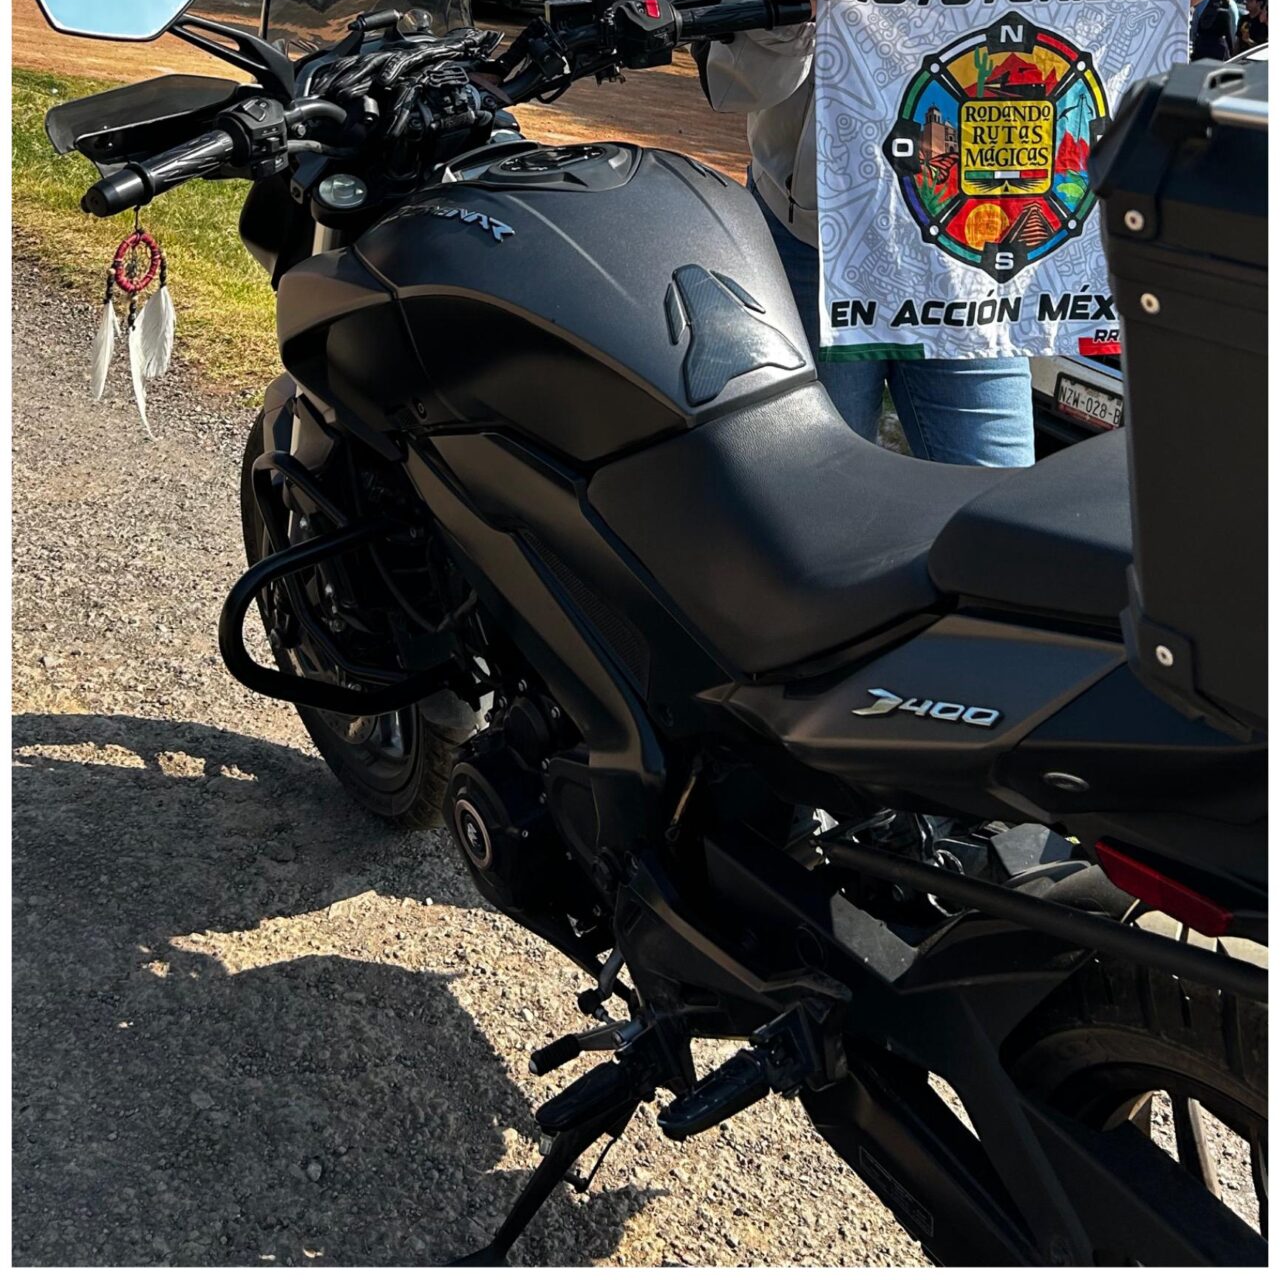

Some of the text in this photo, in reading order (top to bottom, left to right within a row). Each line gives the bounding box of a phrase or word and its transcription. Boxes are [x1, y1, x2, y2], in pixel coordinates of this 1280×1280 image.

[1000, 24, 1023, 43] N
[995, 252, 1014, 269] S
[831, 285, 1120, 328] EN ACCIÓN MÉX
